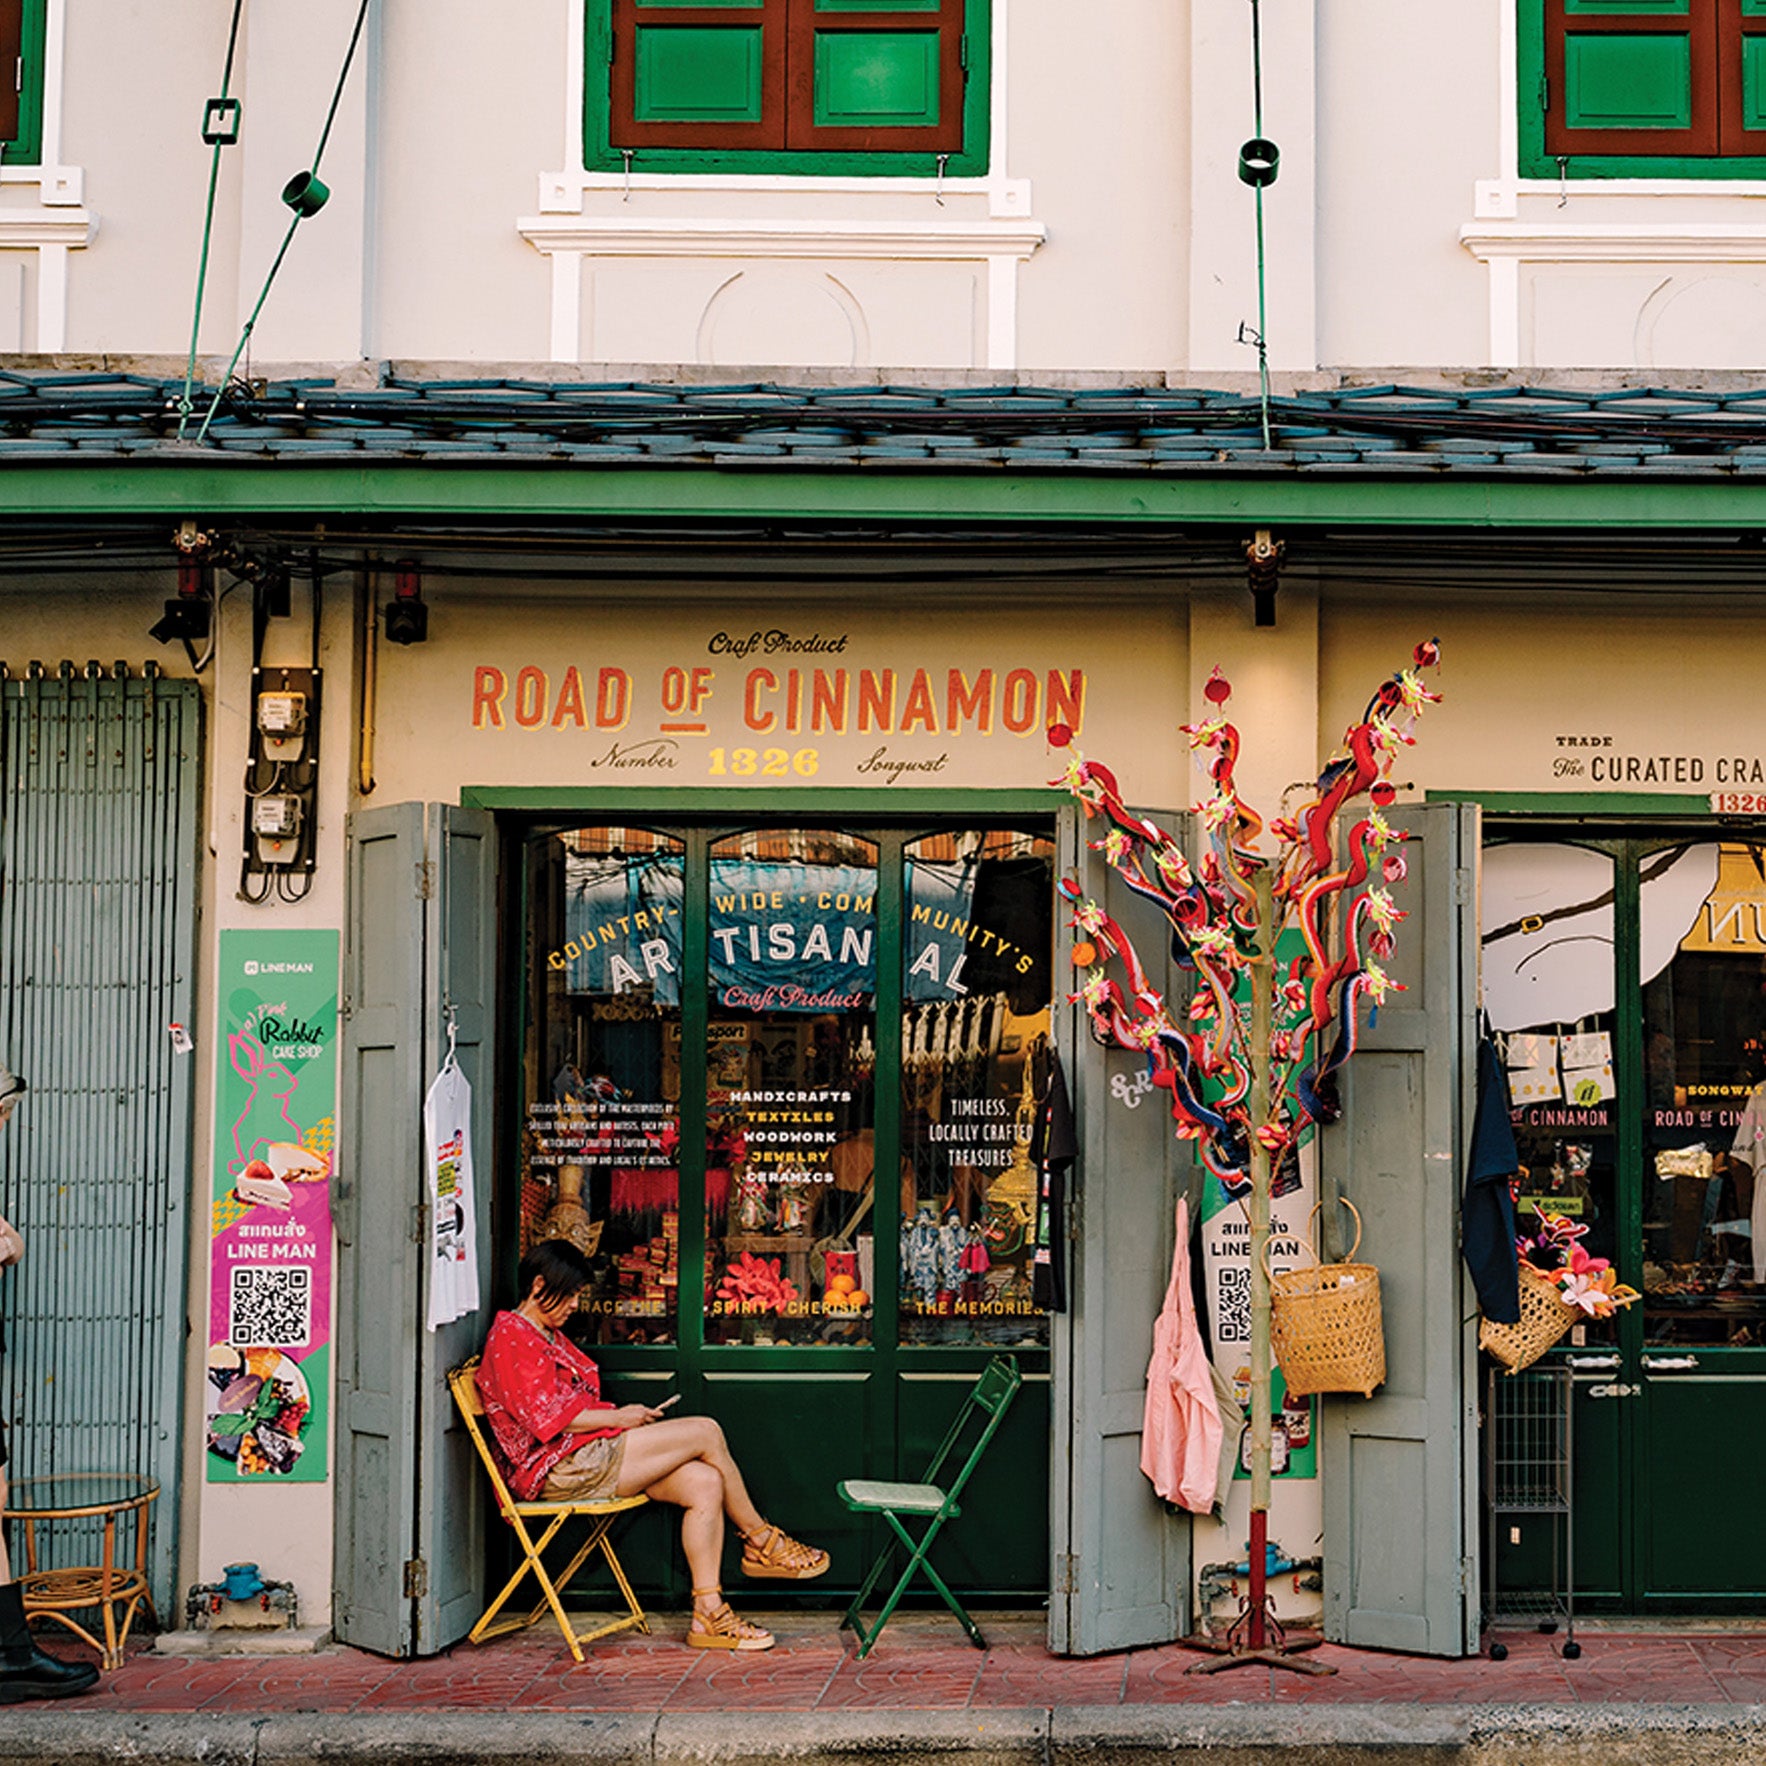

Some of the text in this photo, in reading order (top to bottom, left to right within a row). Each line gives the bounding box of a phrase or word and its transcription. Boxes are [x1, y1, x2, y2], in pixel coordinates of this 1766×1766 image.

[708, 629, 848, 659] Craft Product
[472, 665, 1087, 737] ROAD OF CINNAMON
[1556, 736, 1613, 747] TRADE
[591, 738, 950, 785] Number 1326 Songwat
[1553, 756, 1766, 783] The CURATED CRA
[1718, 793, 1766, 813] 1326
[715, 891, 784, 913] WIDE
[261, 963, 313, 973] LINE MAN
[723, 983, 863, 1013] Craft Product
[260, 1017, 324, 1045] Rabbit
[297, 1045, 324, 1060] SHOP
[730, 1091, 852, 1102] HANDICRAFTS
[747, 1112, 835, 1122] TEXTILES
[1530, 1110, 1608, 1126] CINNAMON
[1655, 1110, 1694, 1127] ROAD
[1700, 1110, 1713, 1122] OF
[743, 1132, 837, 1143] WOODWORK
[929, 1124, 1034, 1141] LOCALLY CRAFTED
[751, 1152, 829, 1163] JEWELRY
[948, 1149, 1013, 1166] TREASURES
[746, 1172, 835, 1183] CERAMICS
[227, 1244, 316, 1259] LINE MAN
[1211, 1241, 1299, 1256] LINE AN
[712, 1301, 768, 1314] SPIRIT
[916, 1301, 948, 1314] THE
